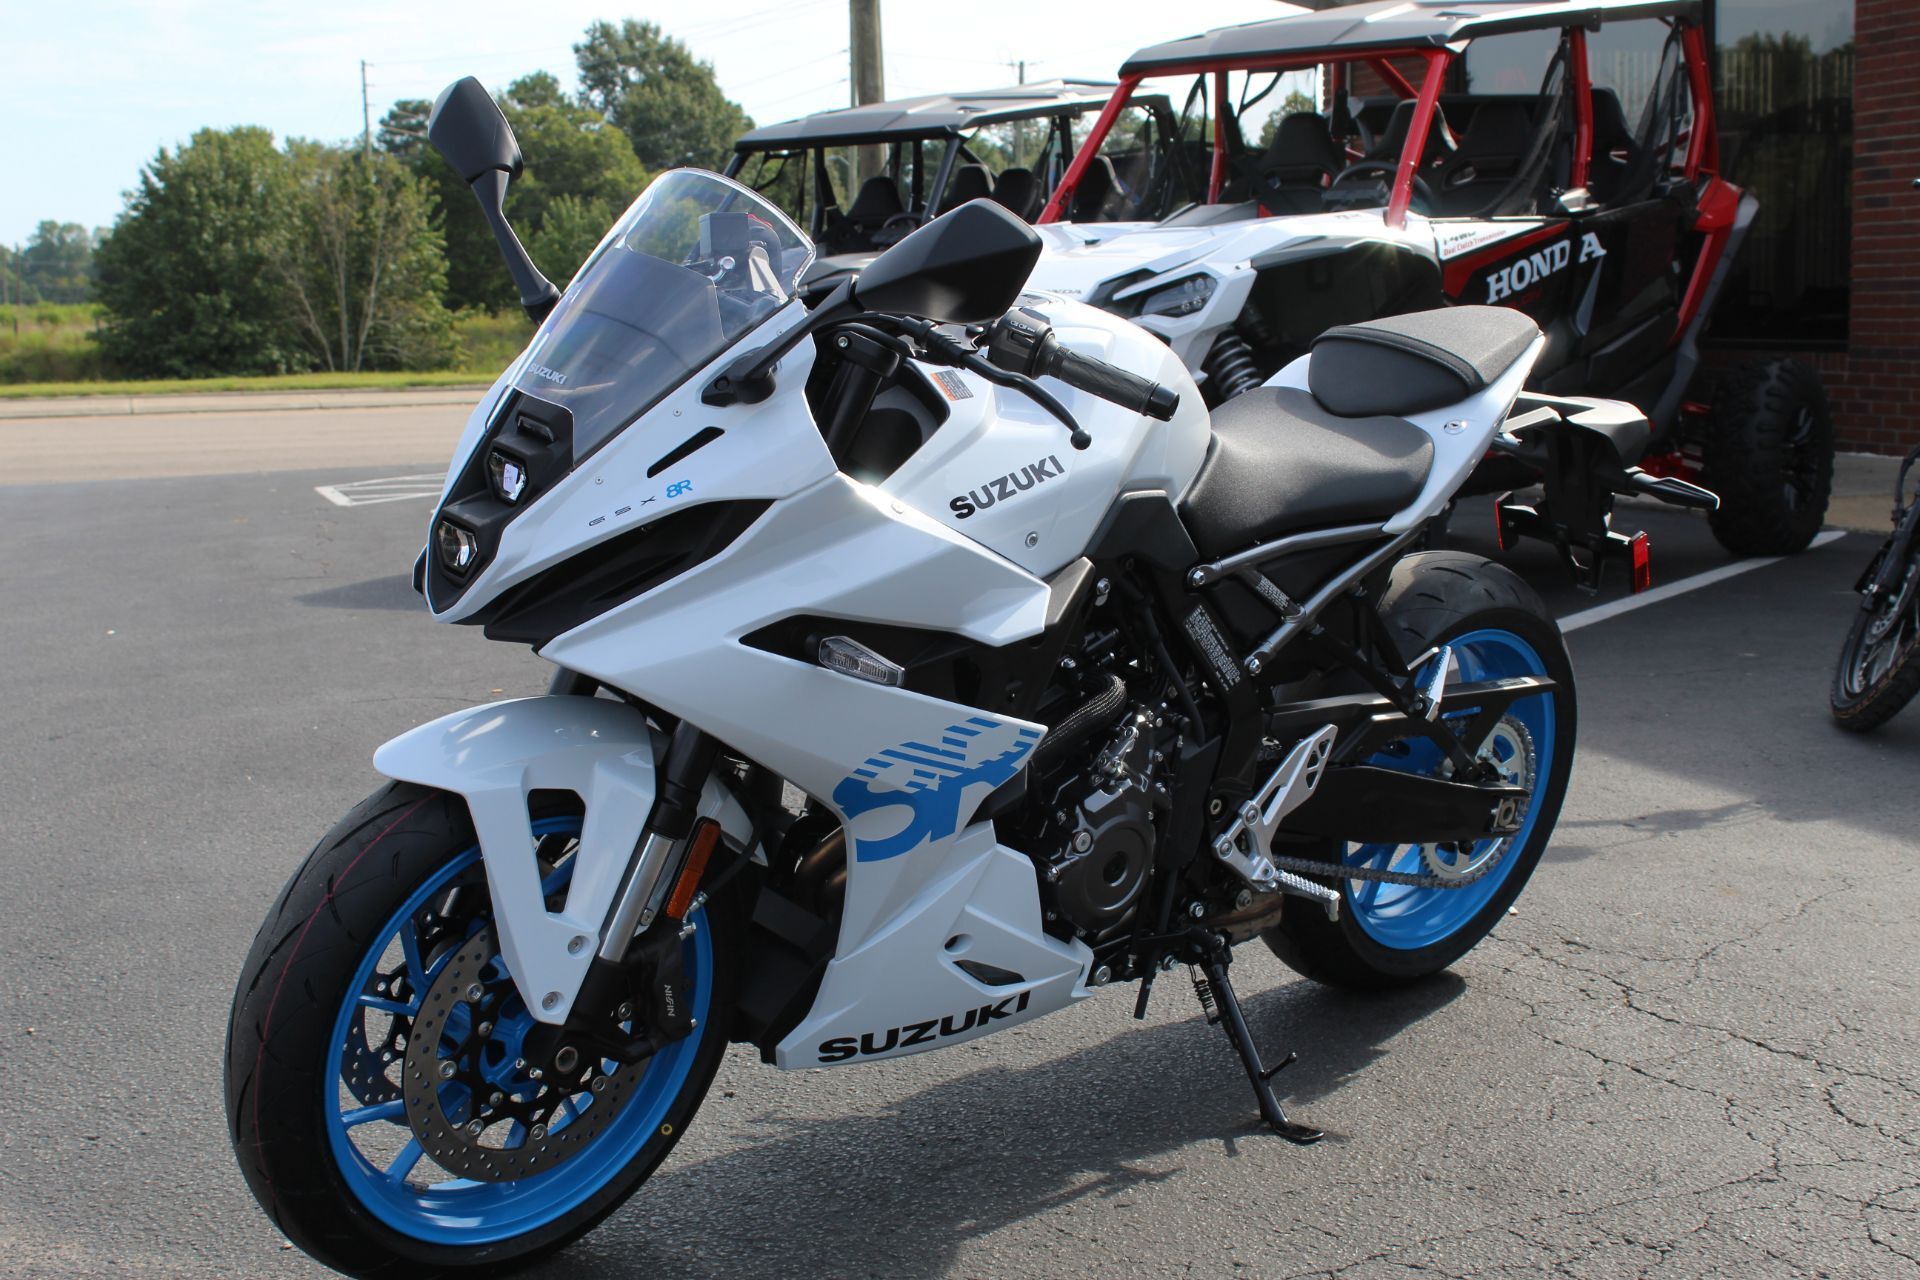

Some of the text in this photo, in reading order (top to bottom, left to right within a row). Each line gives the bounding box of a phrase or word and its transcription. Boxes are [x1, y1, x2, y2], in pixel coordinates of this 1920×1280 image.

[528, 363, 568, 385] SUZUKI
[949, 454, 1065, 519] SUZUKI
[818, 990, 1031, 1063] SUZUKI
